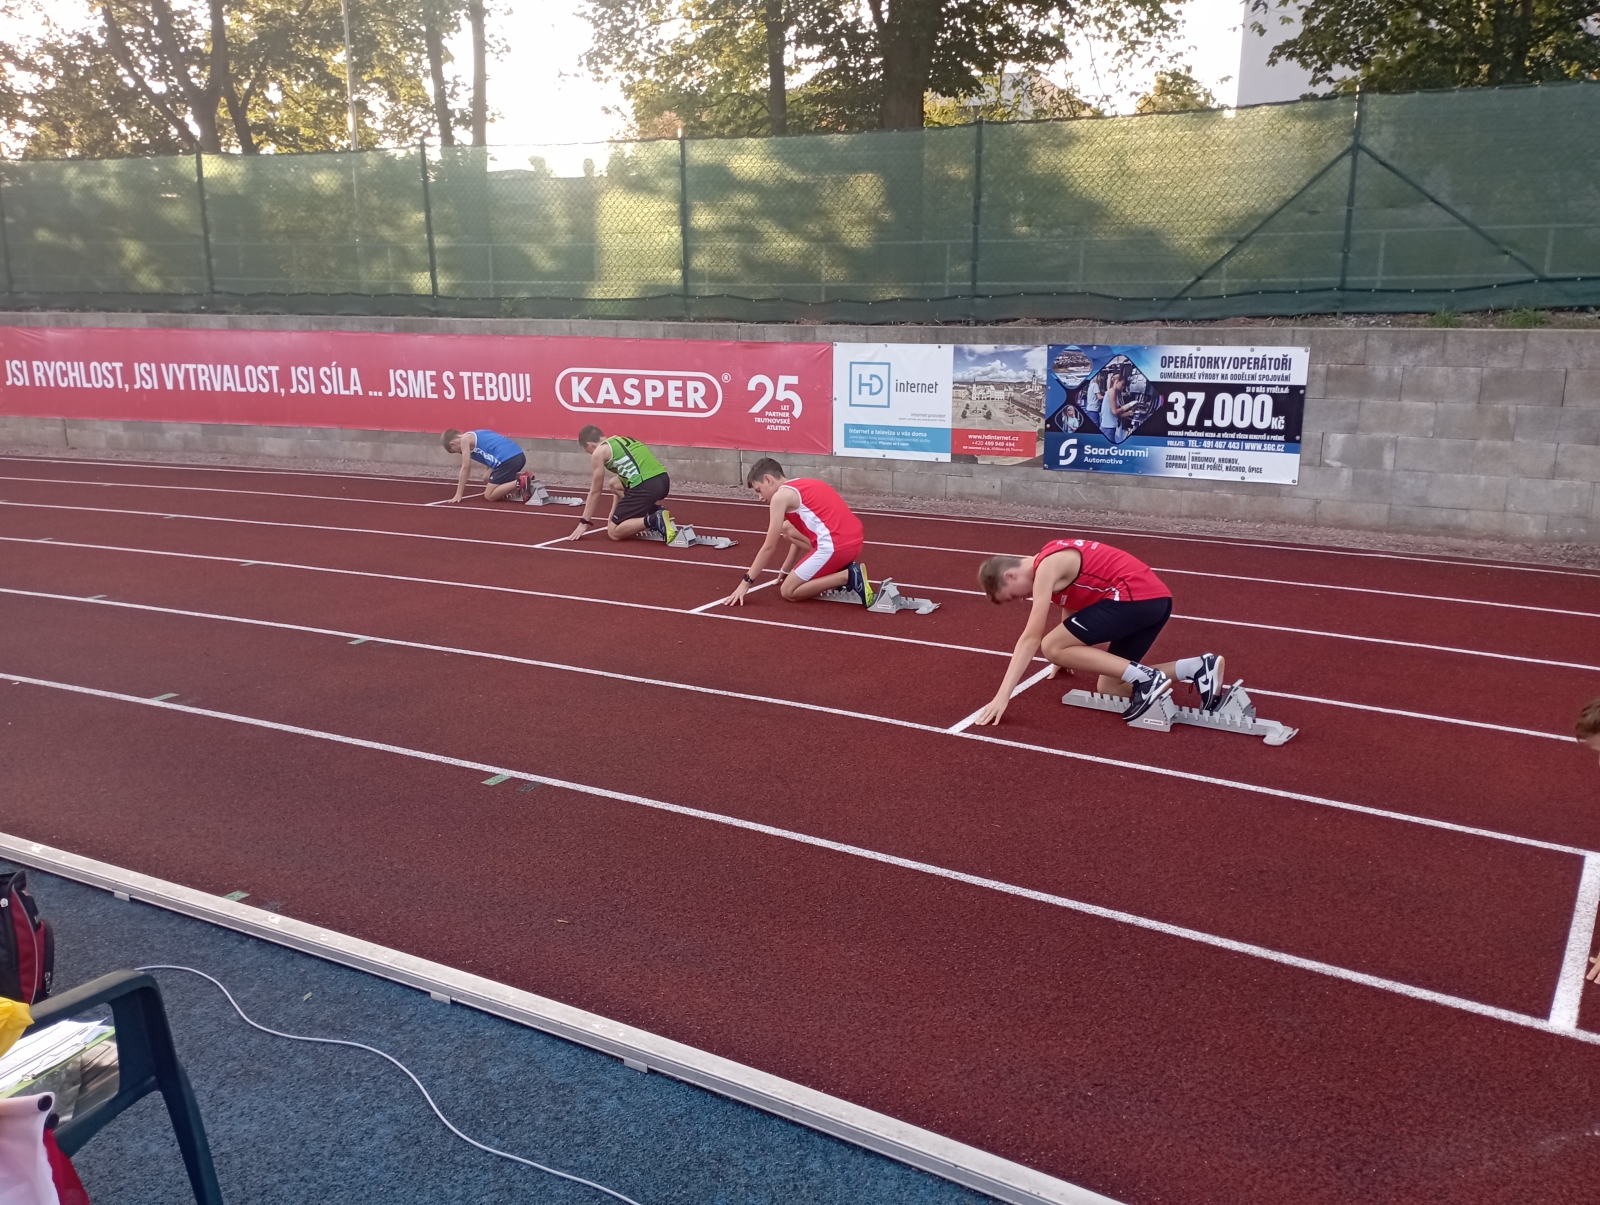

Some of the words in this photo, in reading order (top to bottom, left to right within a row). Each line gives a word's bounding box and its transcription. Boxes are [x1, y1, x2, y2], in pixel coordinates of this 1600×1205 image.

[1160, 353, 1293, 371] OPERÁTORKY/OPERÁTOŘI
[5, 360, 29, 386] JSI
[32, 361, 129, 392] RYCHLOST,
[134, 363, 158, 389] JSI
[161, 363, 285, 397] VYTRVALOST,
[290, 366, 316, 394] JSI
[320, 361, 363, 395] SÍLA
[388, 369, 439, 399] JSME
[442, 371, 456, 400] S
[459, 371, 532, 403] TEBOU!
[1159, 371, 1197, 380] GUMÁRENSKÉ
[1198, 371, 1219, 380] VÝROBY
[1230, 372, 1257, 381] ODDĚLENÍ
[1257, 373, 1291, 382] SPOJOVÁNÍ
[858, 373, 884, 396] HD
[895, 379, 939, 394] internet
[570, 376, 709, 410] KASPER
[747, 374, 803, 419] 25
[1166, 391, 1273, 429] 37.000
[1271, 416, 1285, 430] KČ
[754, 417, 791, 425] TRUTNOVSKÉ
[1084, 445, 1149, 457] SaarGummi
[1203, 440, 1213, 448] 491
[1214, 441, 1226, 449] 467
[1228, 441, 1239, 449] 443
[1245, 442, 1285, 451] WWW.SGC.CZ
[1083, 456, 1123, 464] Automotive
[1191, 456, 1216, 464] BROUMOV,
[1191, 462, 1205, 470] VELKÉ
[1225, 464, 1247, 473] NÁCHOD,
[1248, 465, 1263, 474] ÚPICE
